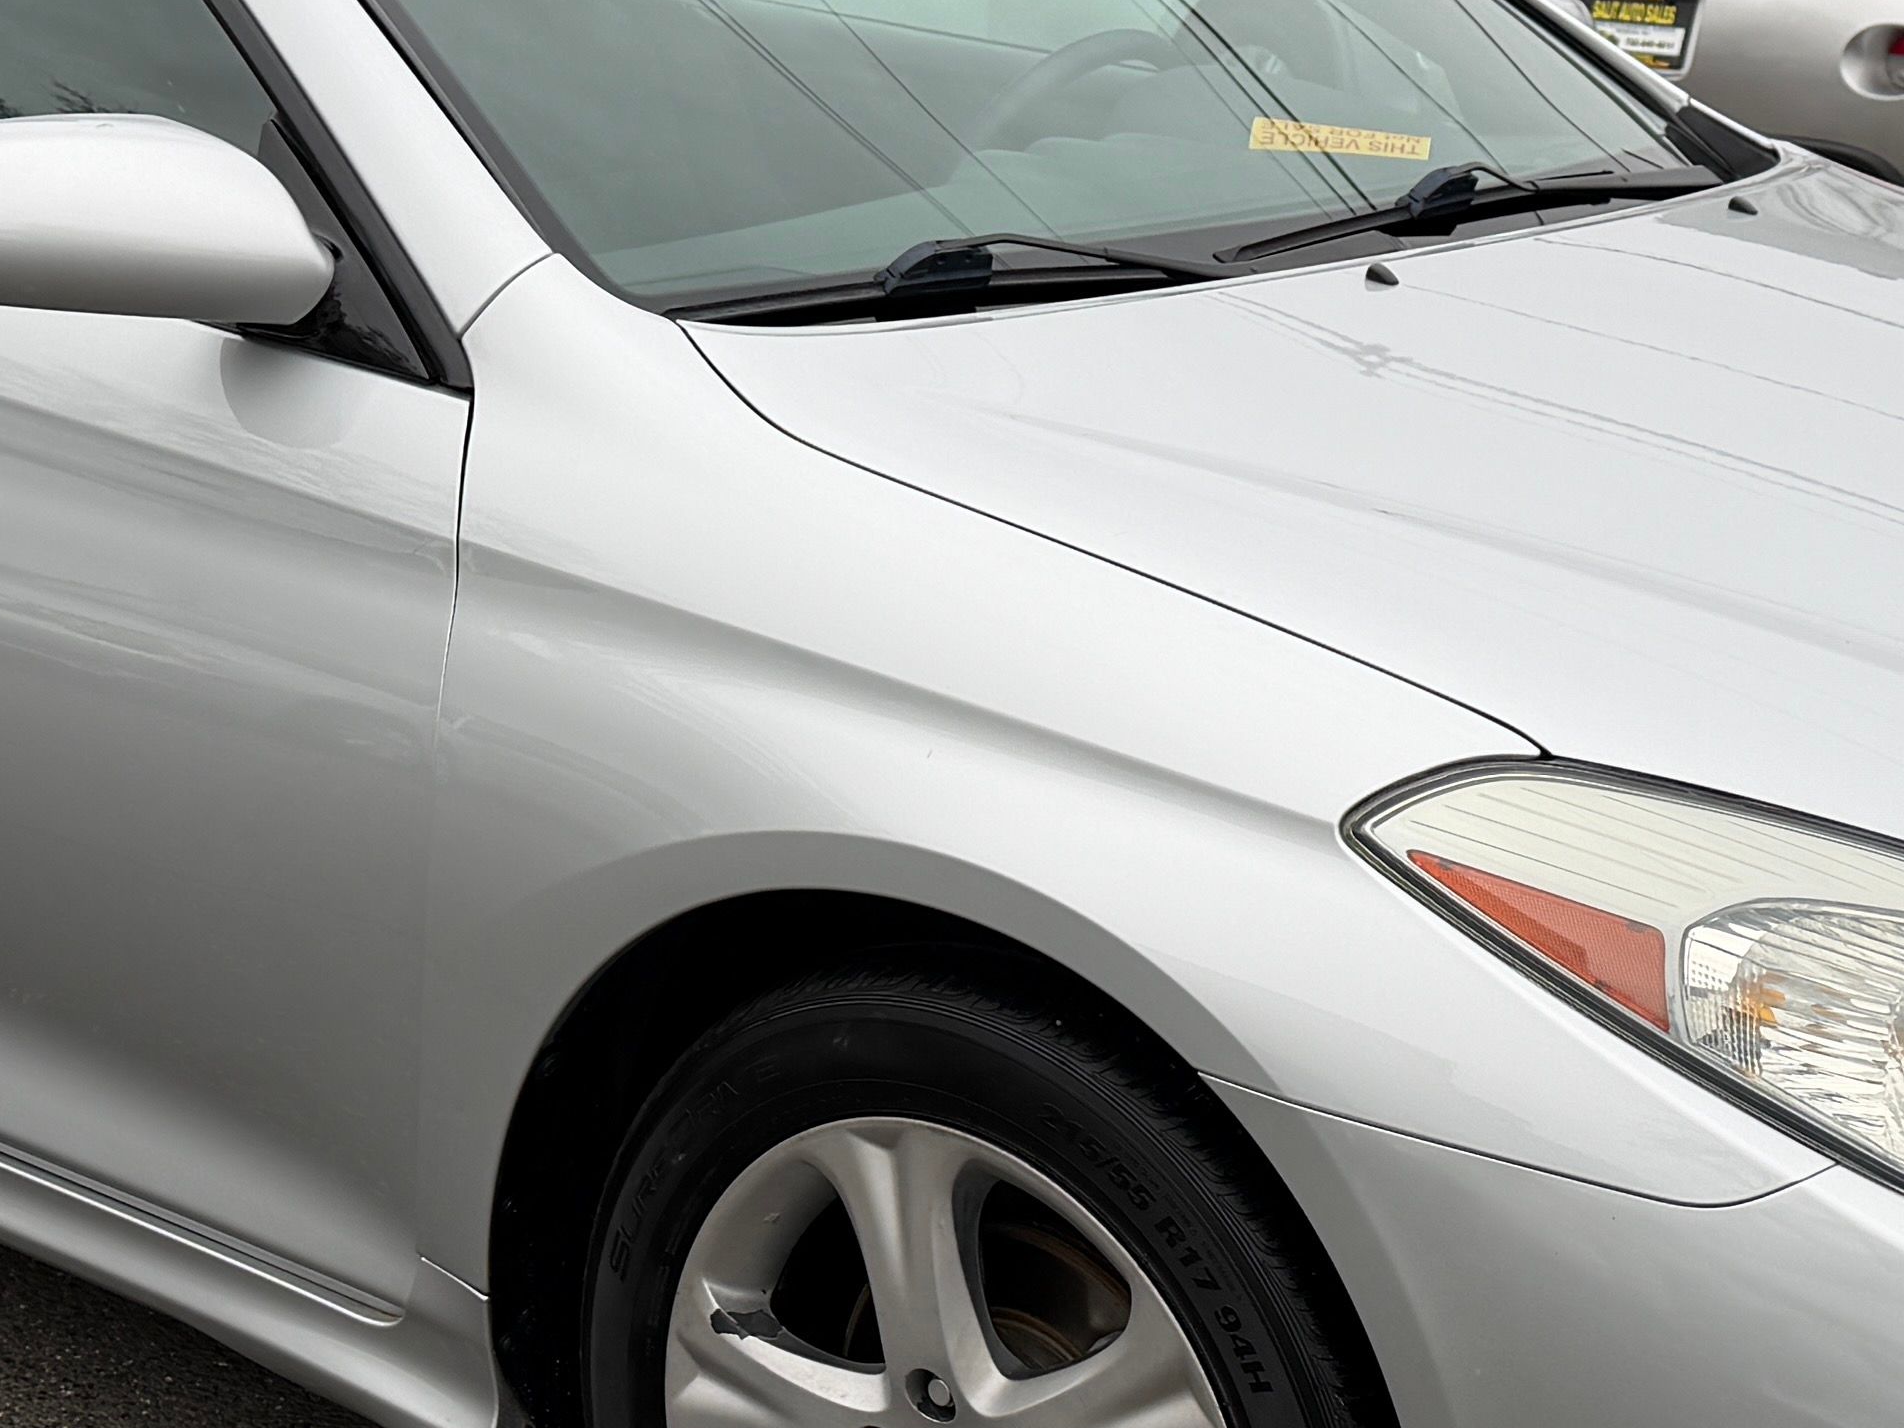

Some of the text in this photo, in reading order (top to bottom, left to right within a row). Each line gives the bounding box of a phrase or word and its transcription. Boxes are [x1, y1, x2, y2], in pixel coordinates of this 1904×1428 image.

[1619, 1, 1646, 22] AUTO
[1645, 4, 1677, 25] SALES
[1260, 130, 1420, 156] THIS VEHICLE
[1154, 1215, 1223, 1292] R17
[1213, 1304, 1275, 1394] 94H
